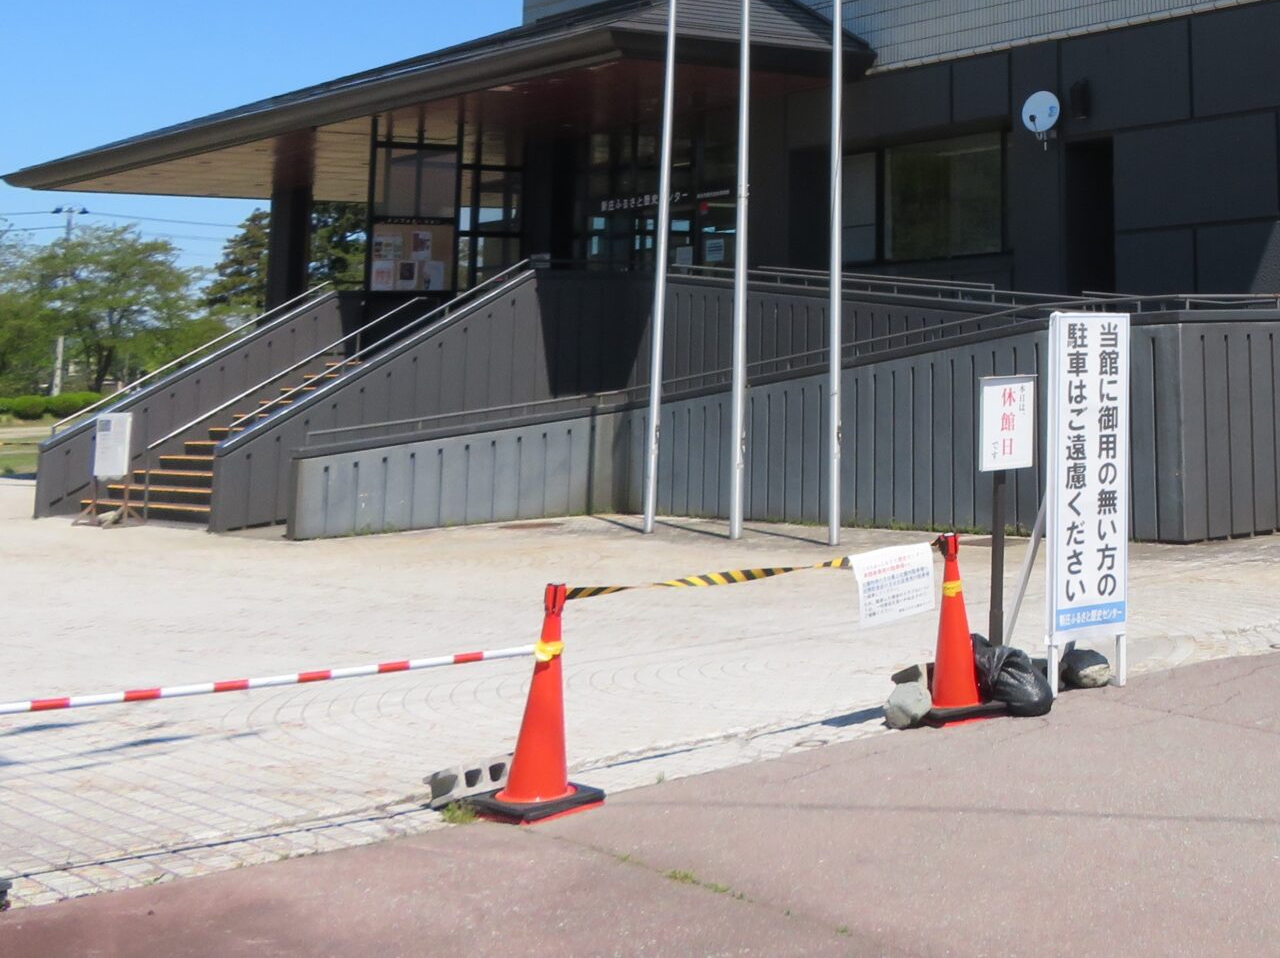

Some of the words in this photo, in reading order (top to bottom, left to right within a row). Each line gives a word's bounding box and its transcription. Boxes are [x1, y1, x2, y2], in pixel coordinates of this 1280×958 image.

[1000, 387, 1017, 457] 休館日
[1065, 323, 1089, 602] 駐車はご遠慮ください
[1096, 322, 1120, 597] 当館に御用の無い方の
